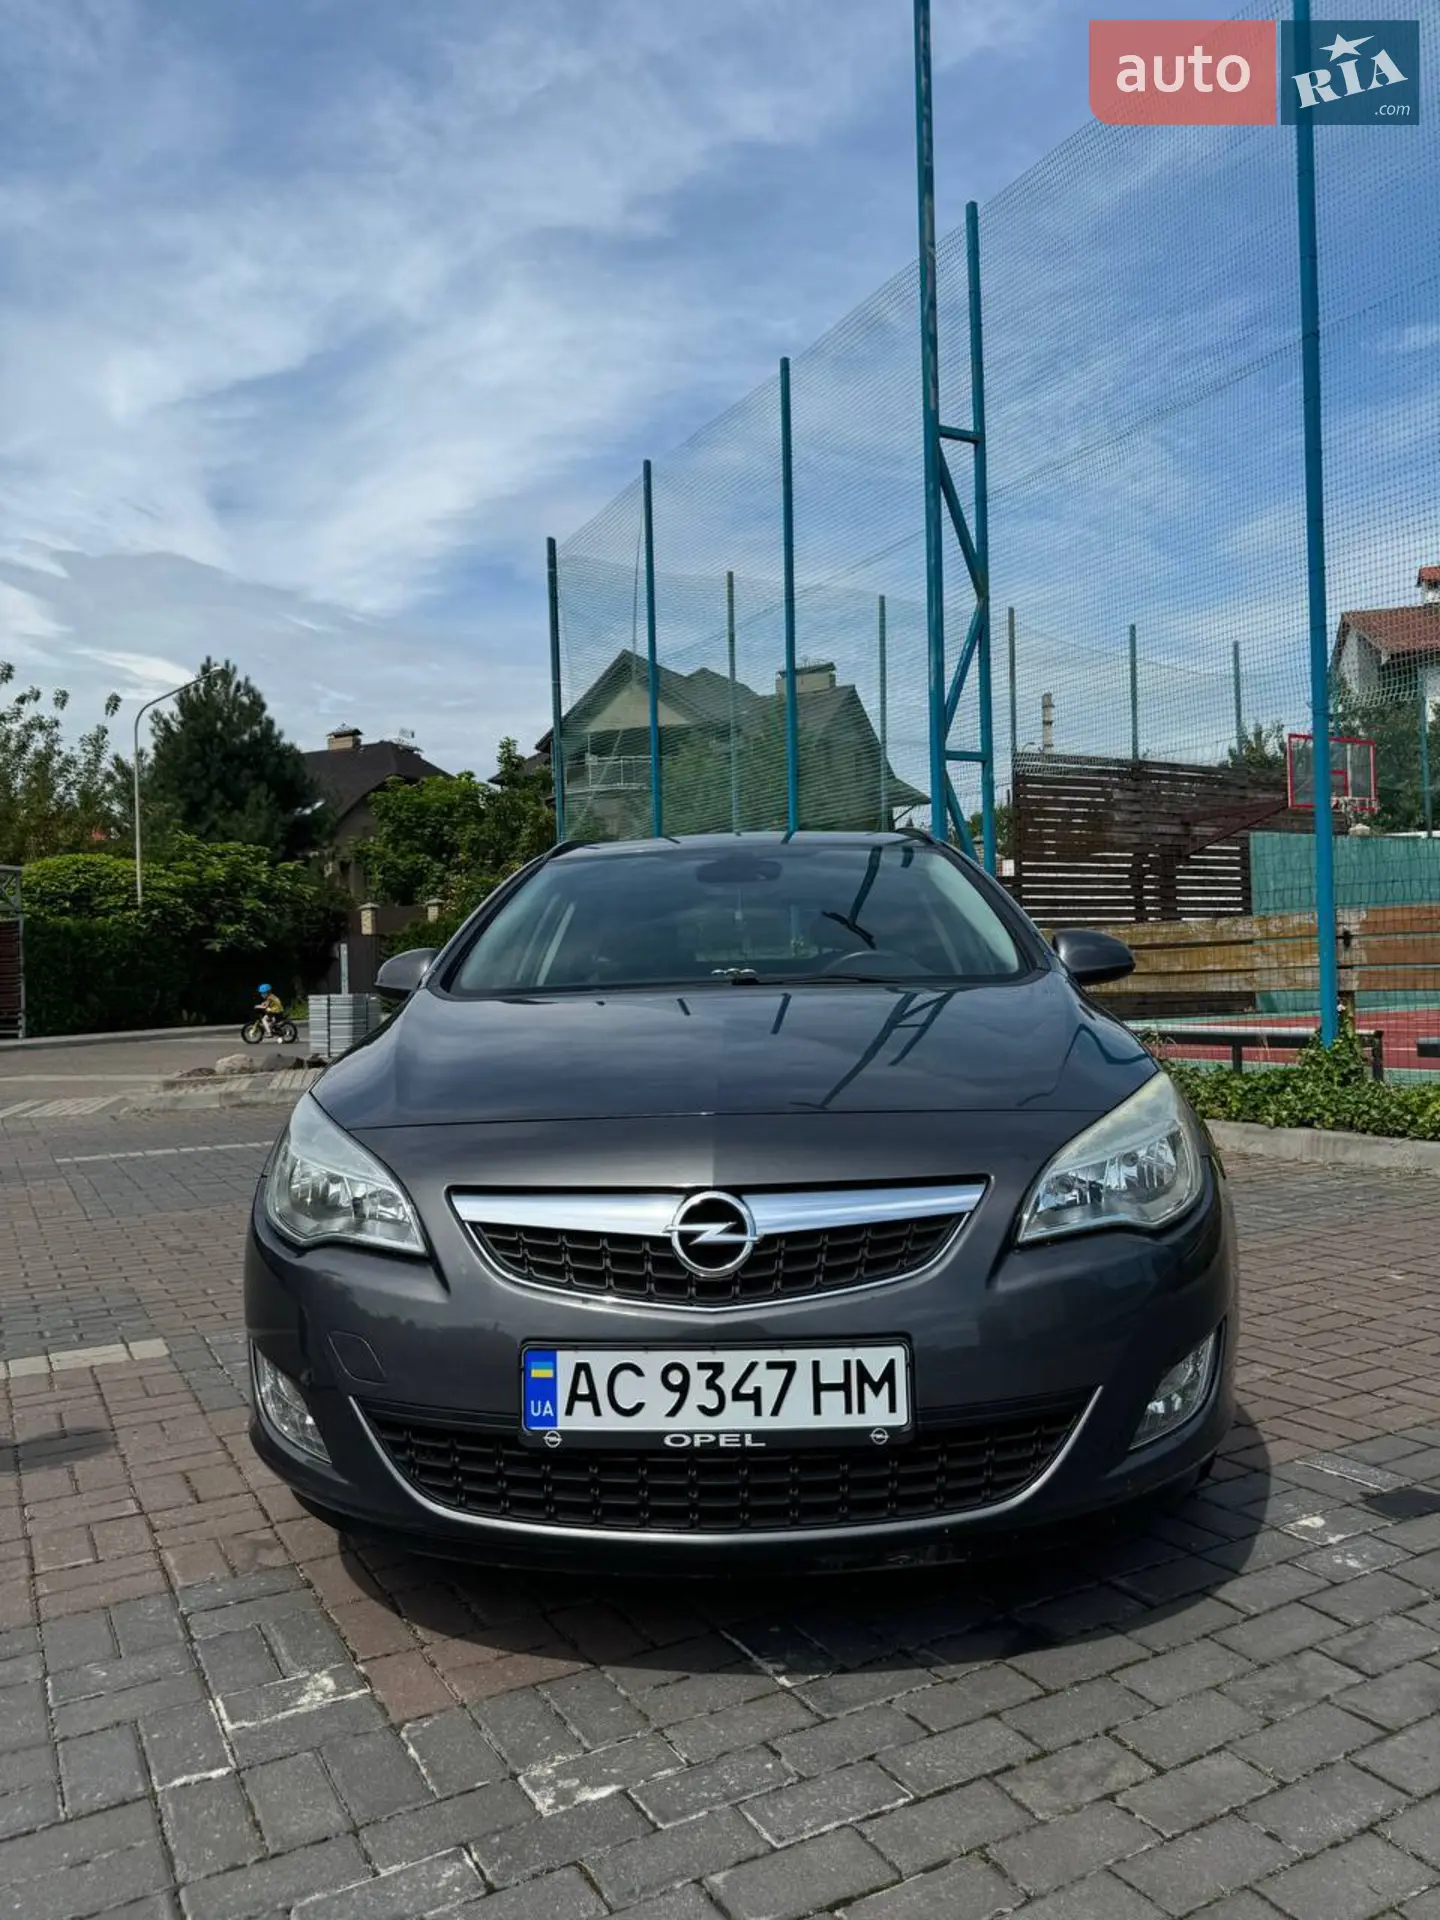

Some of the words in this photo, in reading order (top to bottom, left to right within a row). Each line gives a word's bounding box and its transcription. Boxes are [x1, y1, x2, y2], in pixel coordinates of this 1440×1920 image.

[564, 1361, 646, 1417] AC
[660, 1361, 797, 1418] 9347
[812, 1358, 897, 1415] HM
[531, 1400, 554, 1417] UA
[663, 1433, 766, 1447] OPEL
